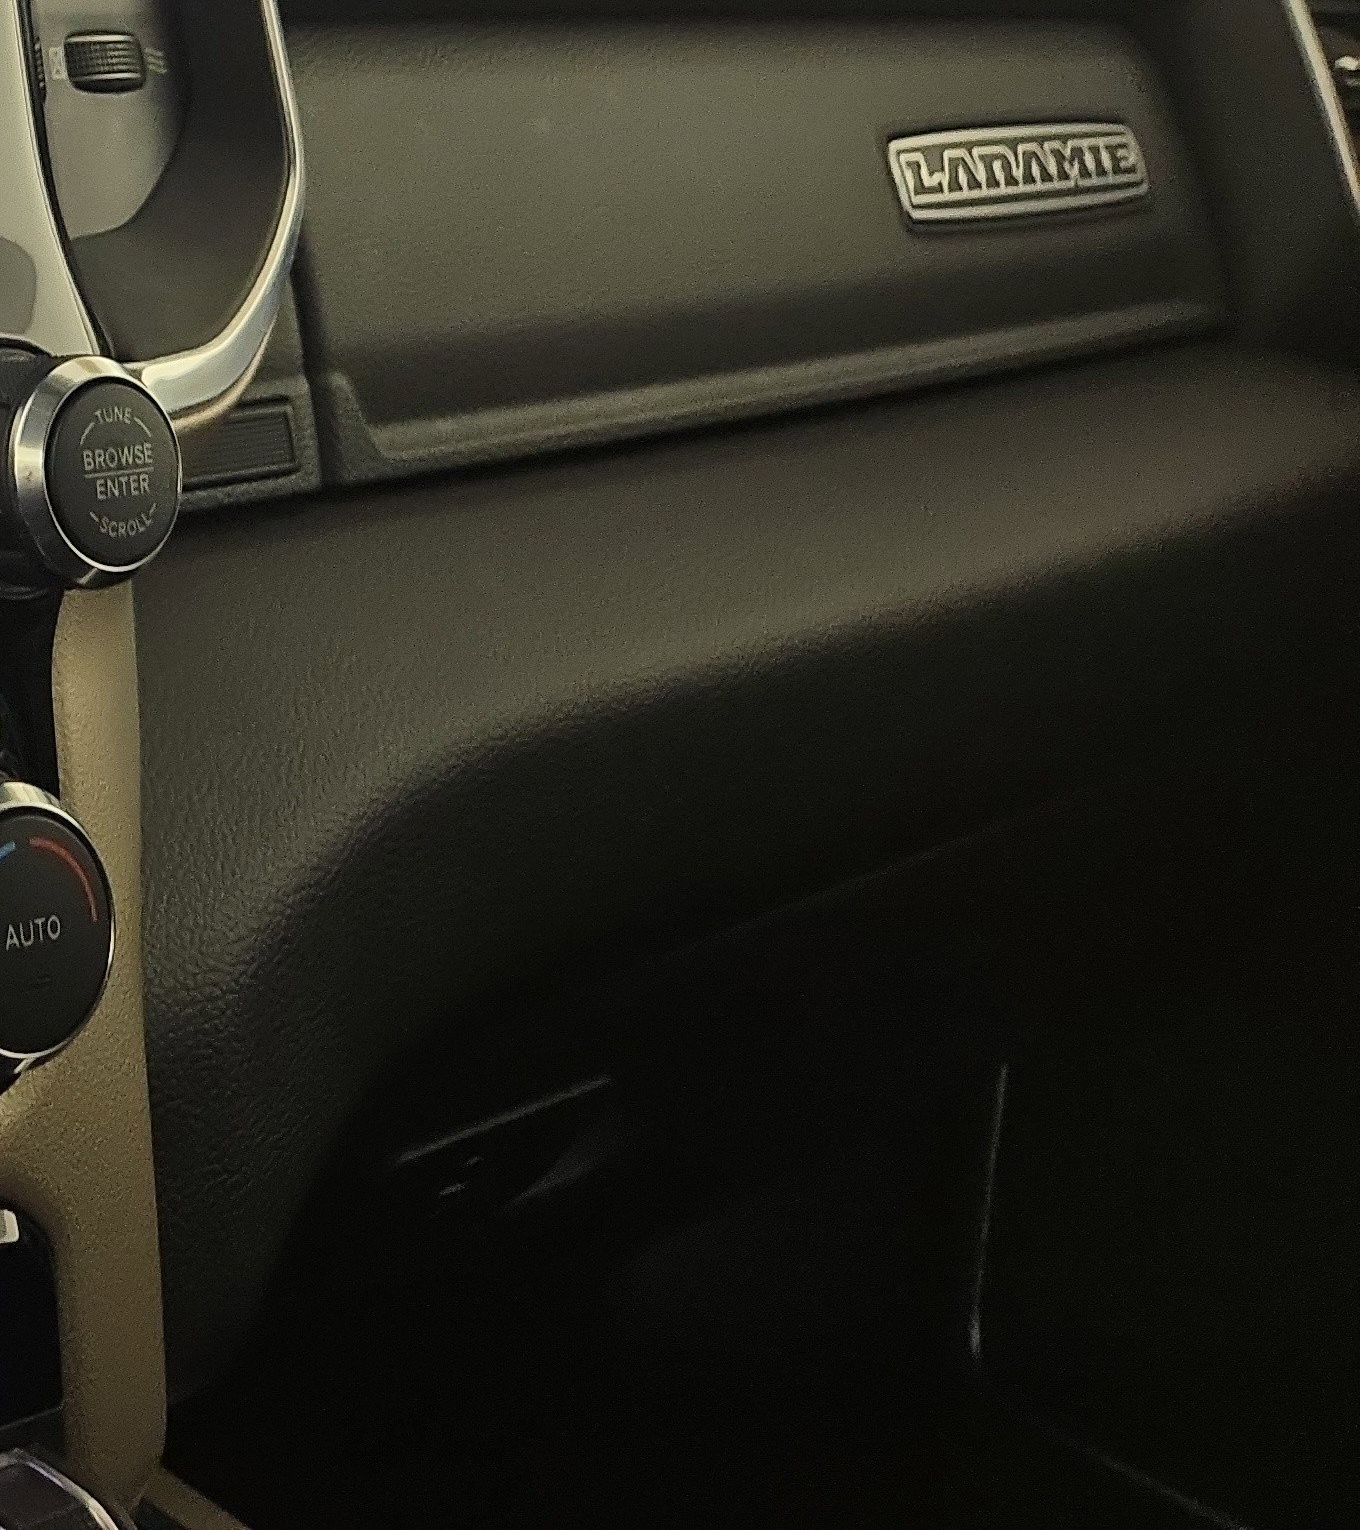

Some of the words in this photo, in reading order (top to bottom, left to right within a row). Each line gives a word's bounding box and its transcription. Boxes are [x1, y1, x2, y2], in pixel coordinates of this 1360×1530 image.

[899, 134, 1140, 206] LARAMIE
[95, 405, 133, 426] TUNE
[82, 441, 154, 469] BROWSE
[95, 473, 151, 501] ENTER
[99, 510, 153, 540] SCROLL
[4, 913, 62, 952] AUTO
